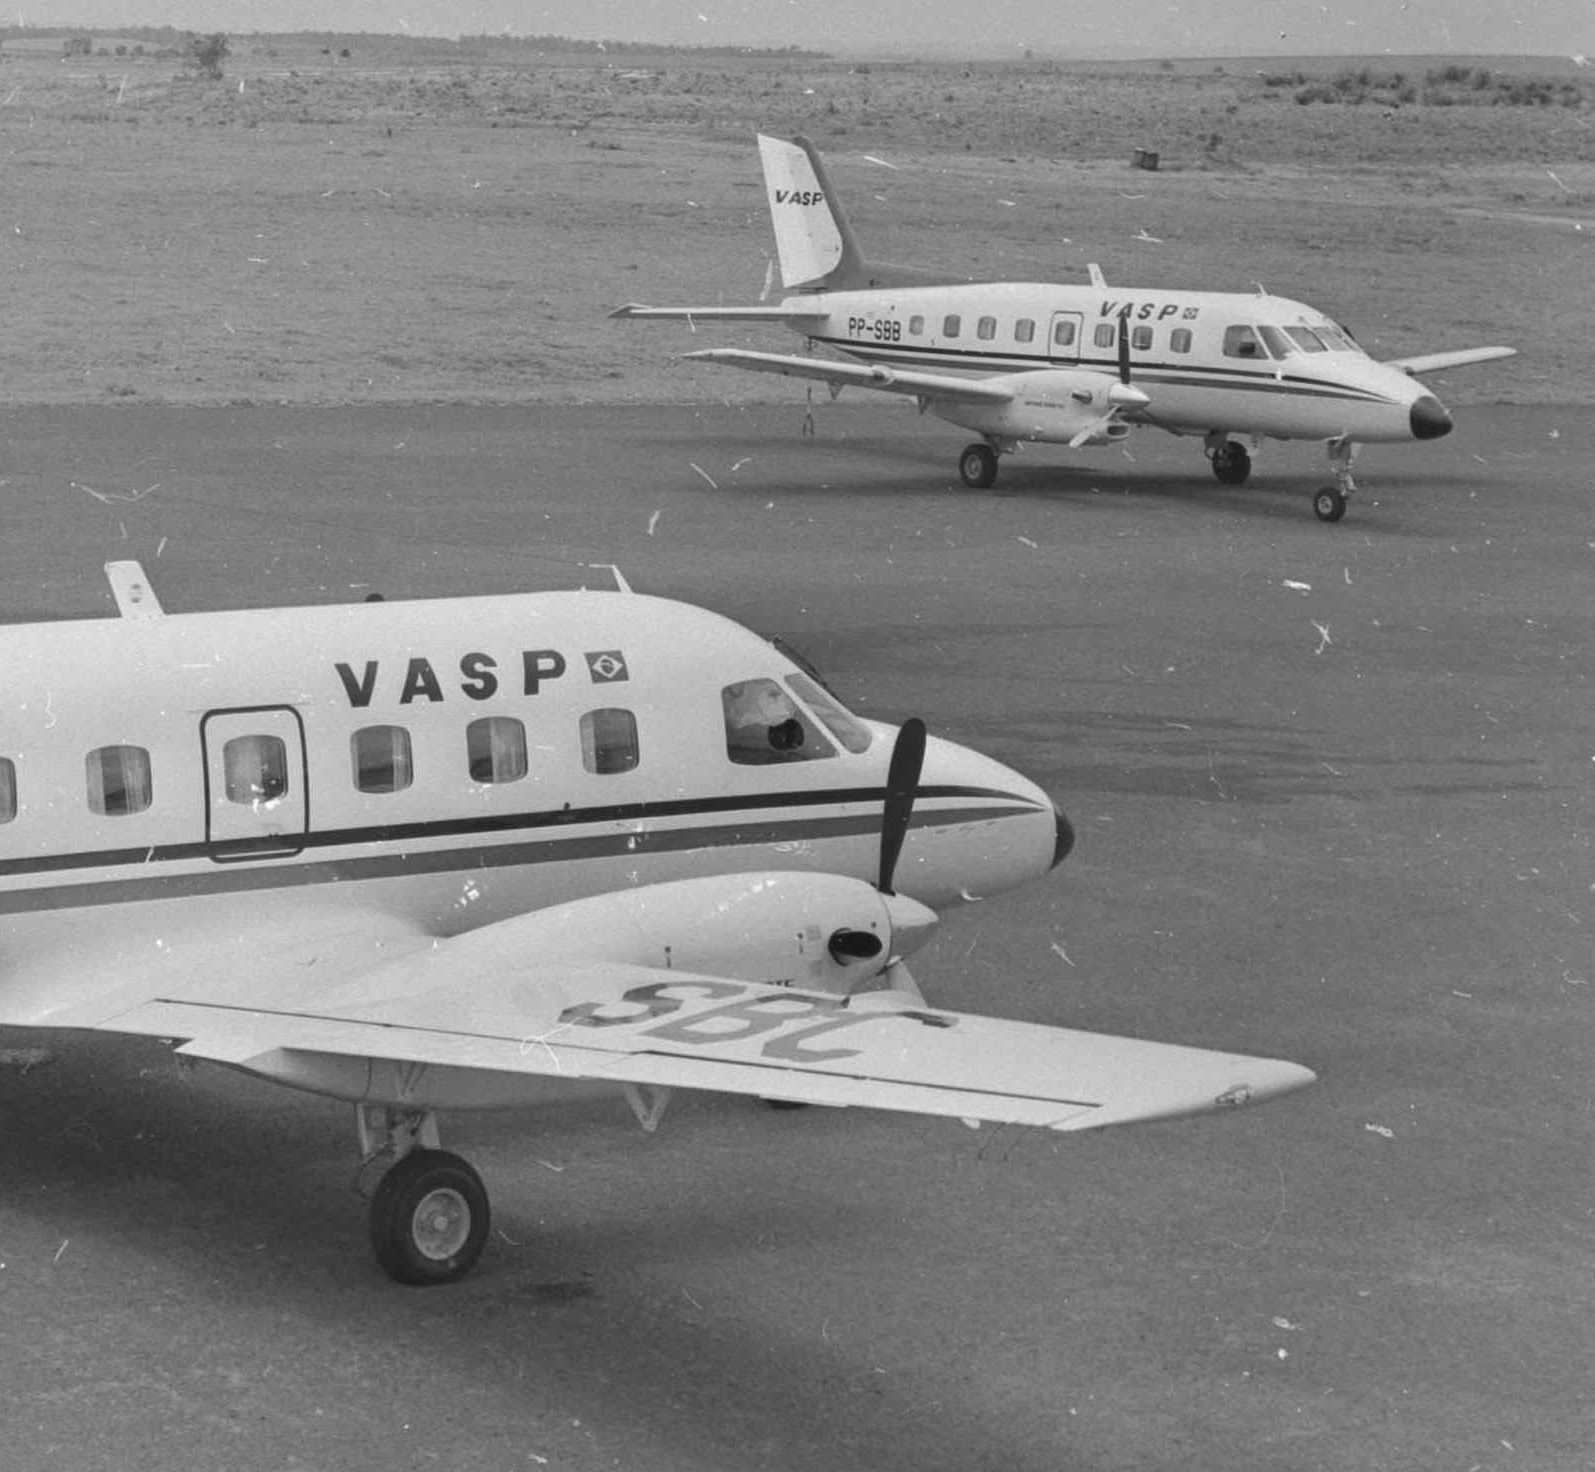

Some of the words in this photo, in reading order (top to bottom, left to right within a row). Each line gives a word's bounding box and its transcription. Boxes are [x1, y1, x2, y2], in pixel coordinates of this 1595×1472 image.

[775, 189, 823, 207] VASP
[1100, 301, 1179, 321] VASP
[848, 317, 902, 341] PP-SBB
[334, 649, 566, 708] VASP
[557, 980, 958, 1062] SBC
